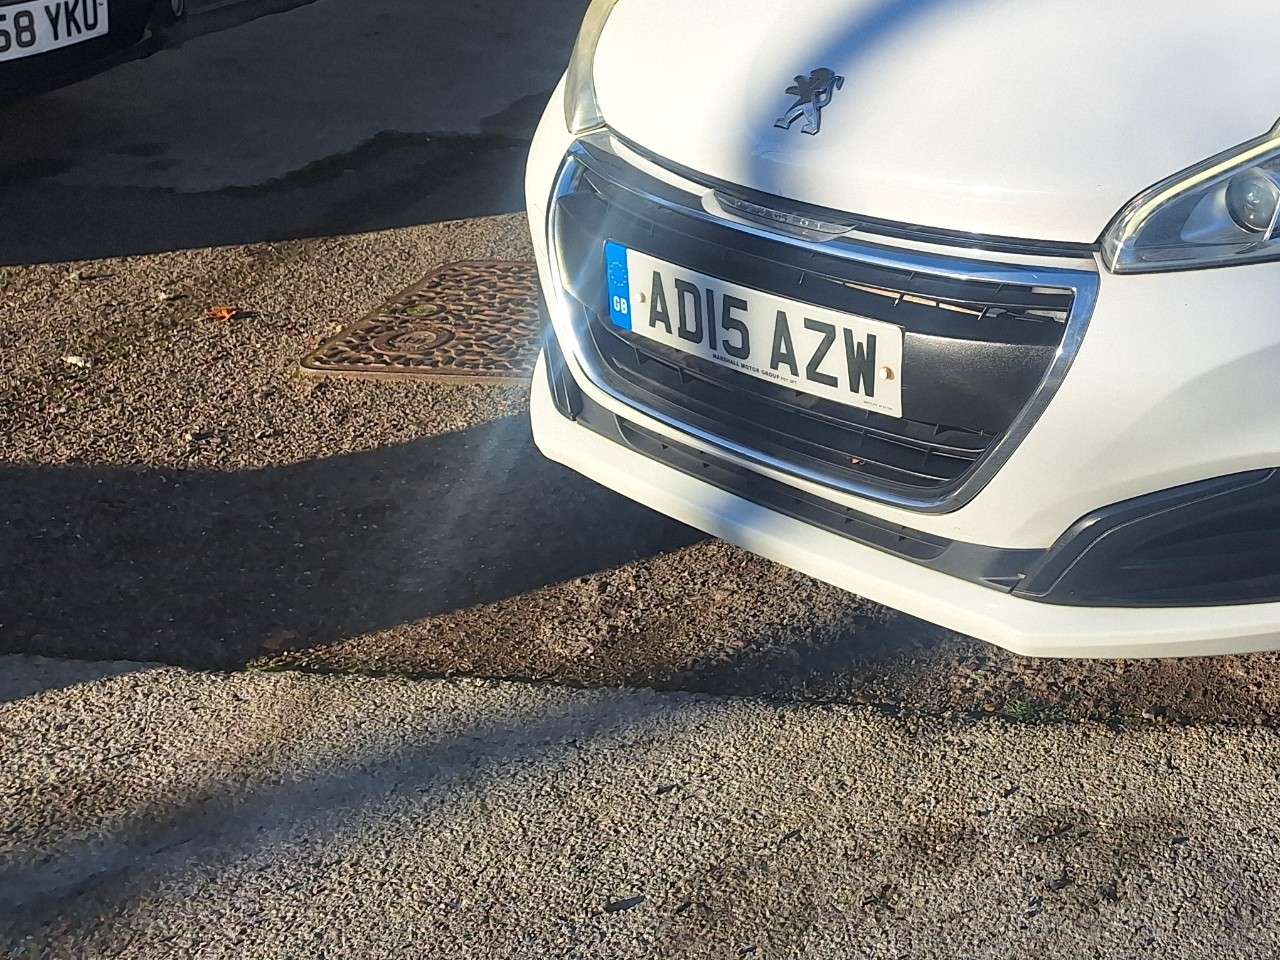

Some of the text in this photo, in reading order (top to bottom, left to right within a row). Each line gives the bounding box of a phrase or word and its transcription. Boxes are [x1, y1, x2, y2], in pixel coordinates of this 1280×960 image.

[734, 199, 822, 230] PUGOT
[613, 295, 628, 314] GB
[648, 270, 877, 398] AD15 AZW
